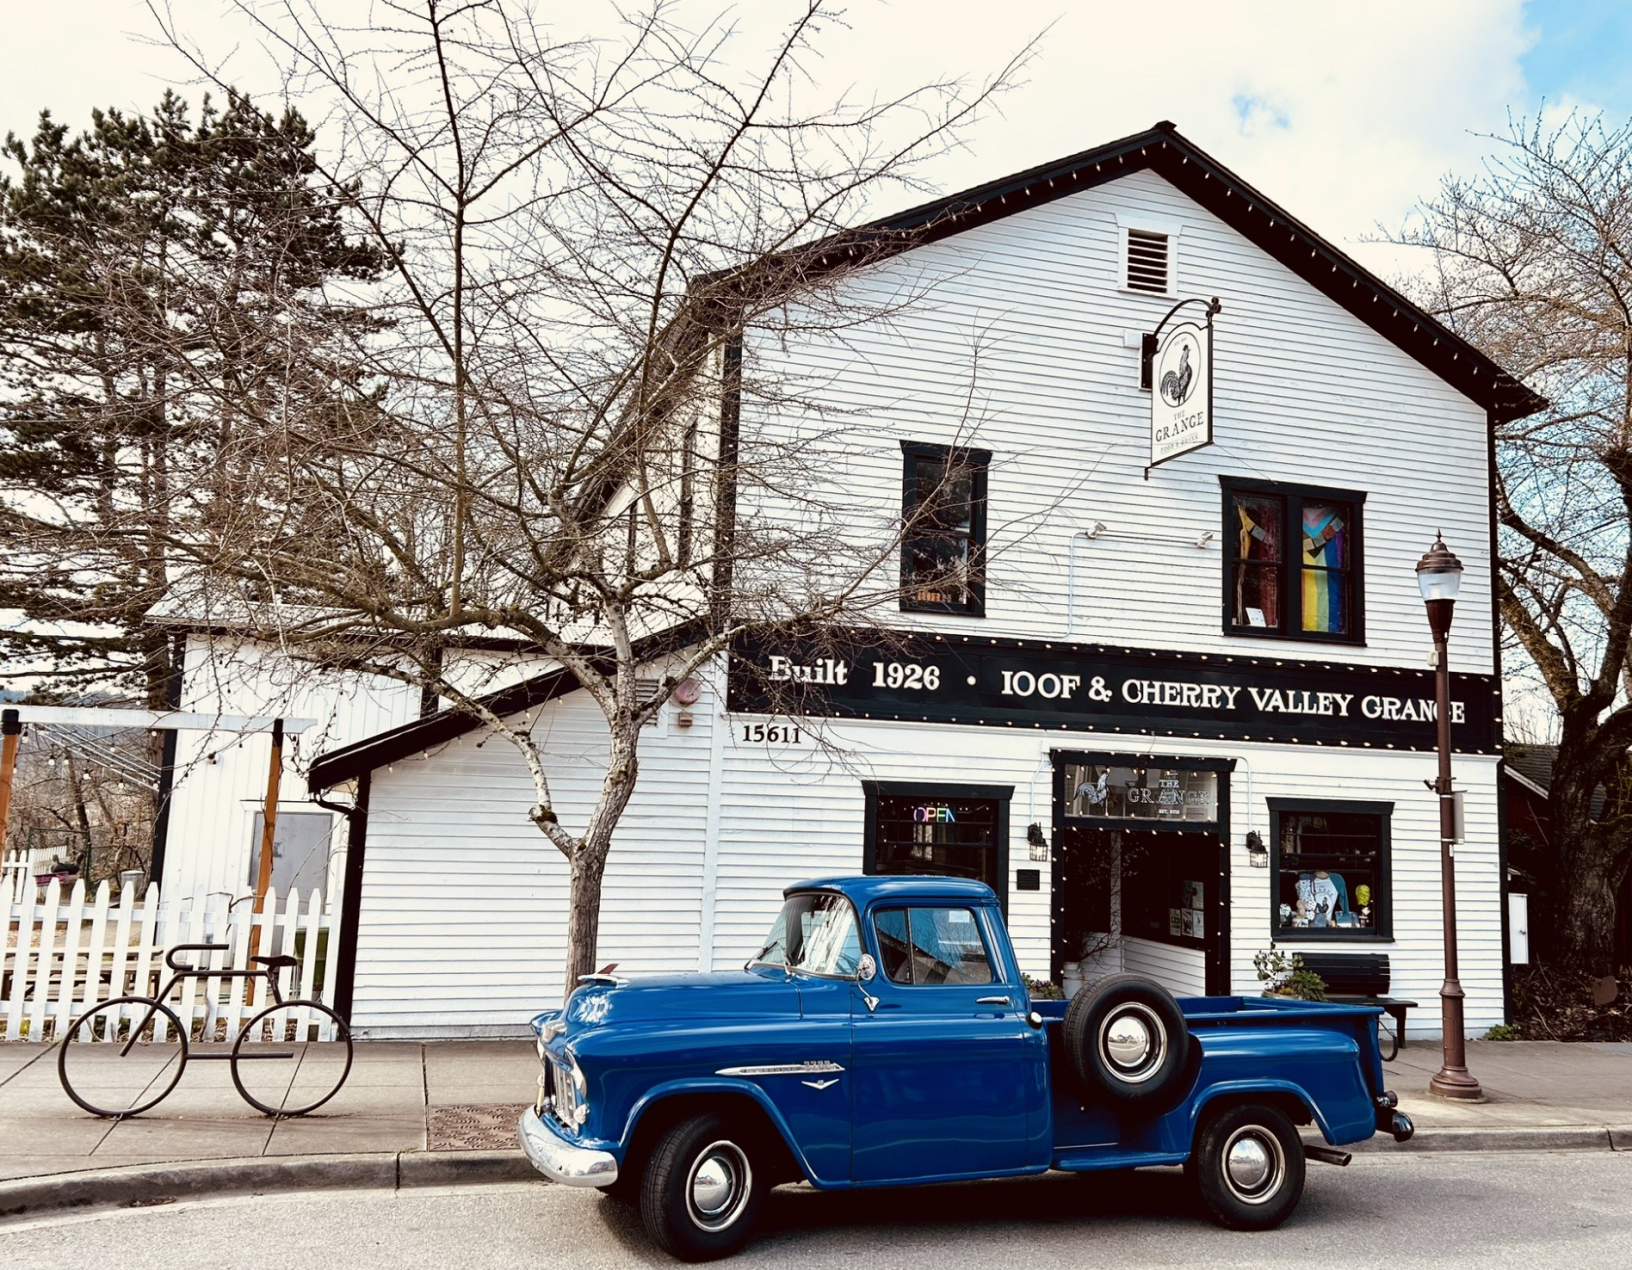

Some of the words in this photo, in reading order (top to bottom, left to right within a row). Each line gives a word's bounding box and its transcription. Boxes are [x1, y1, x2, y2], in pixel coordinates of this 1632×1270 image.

[1173, 410, 1186, 421] THE
[1155, 411, 1204, 442] GRANGE
[768, 655, 848, 685] Built
[872, 661, 941, 690] 1926
[1001, 670, 1081, 699] IOOF
[1088, 675, 1113, 703] &
[1122, 678, 1242, 710] CHERRY
[1247, 687, 1354, 717] VALLEY
[742, 724, 801, 744] 15611
[1159, 779, 1180, 788] THE
[1127, 787, 1210, 806] GRANGE
[913, 806, 956, 823] OPEN
